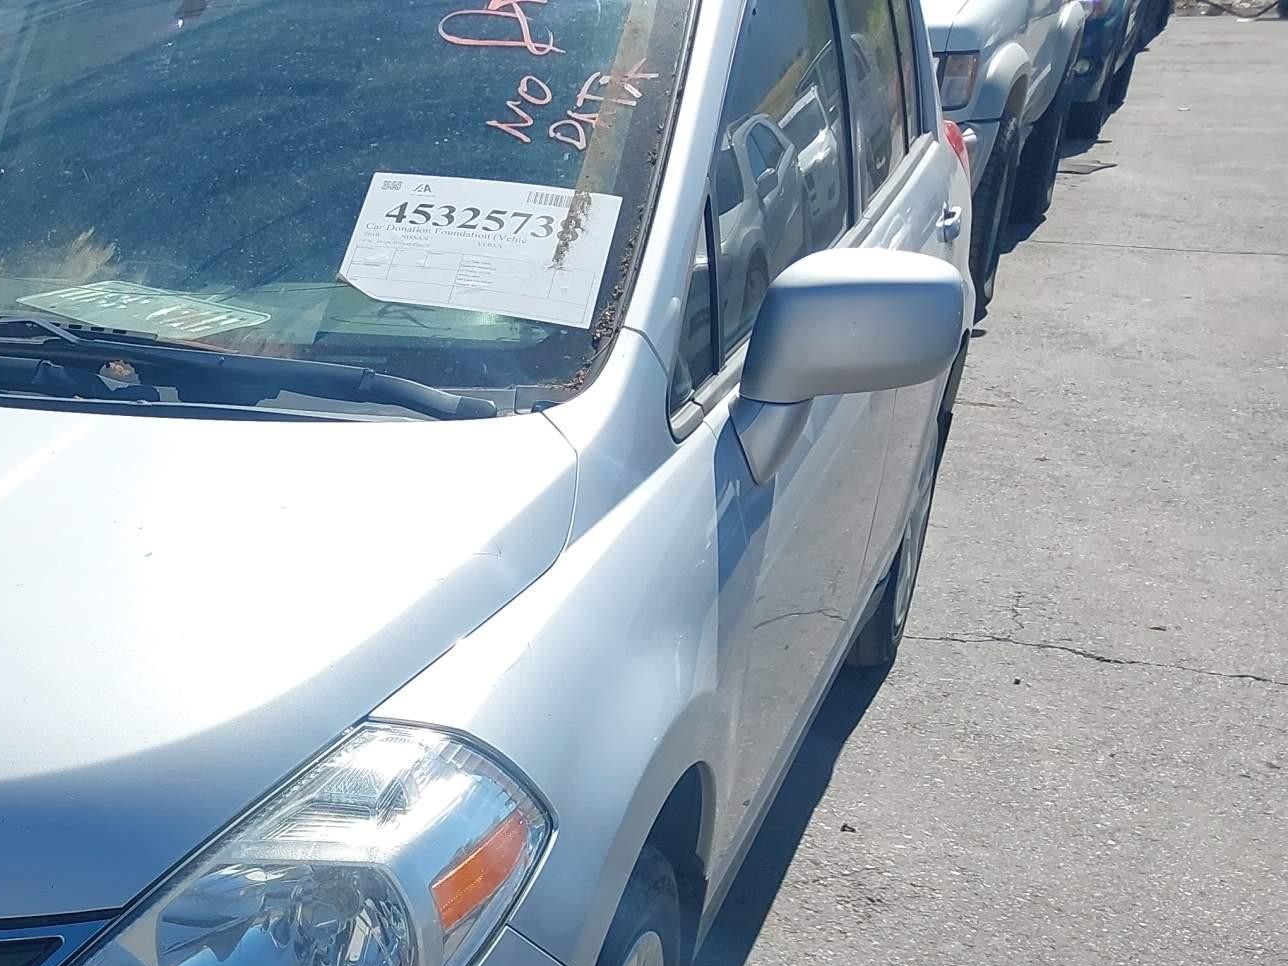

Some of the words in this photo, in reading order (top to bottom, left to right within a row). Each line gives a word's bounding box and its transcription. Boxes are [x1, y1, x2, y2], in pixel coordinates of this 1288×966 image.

[485, 75, 553, 143] NO
[366, 222, 385, 231] Car
[386, 223, 432, 235] Donation
[433, 227, 491, 240] Foundation
